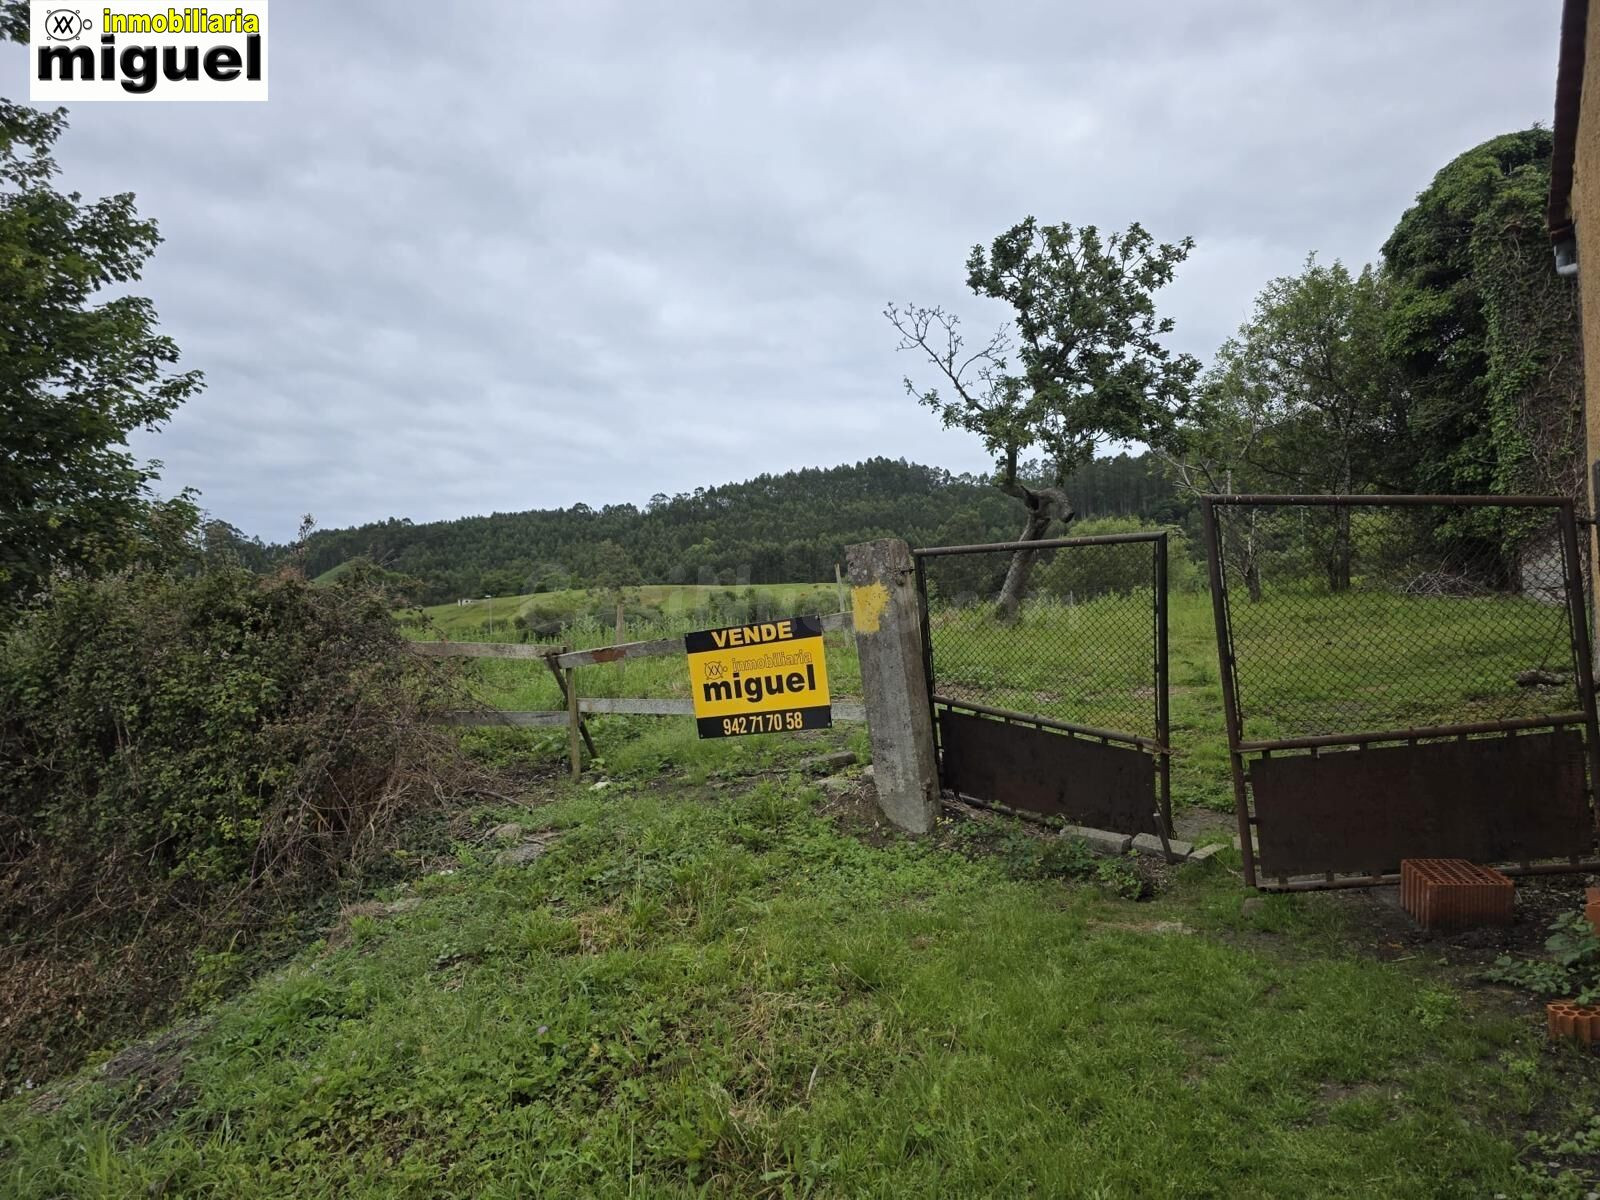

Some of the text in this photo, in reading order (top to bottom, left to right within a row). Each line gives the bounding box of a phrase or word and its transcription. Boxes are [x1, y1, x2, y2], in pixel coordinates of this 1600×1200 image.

[711, 621, 793, 648] VENDE
[732, 649, 813, 672] inmobiliaria
[703, 664, 816, 703] miguel
[786, 712, 803, 729] 58
